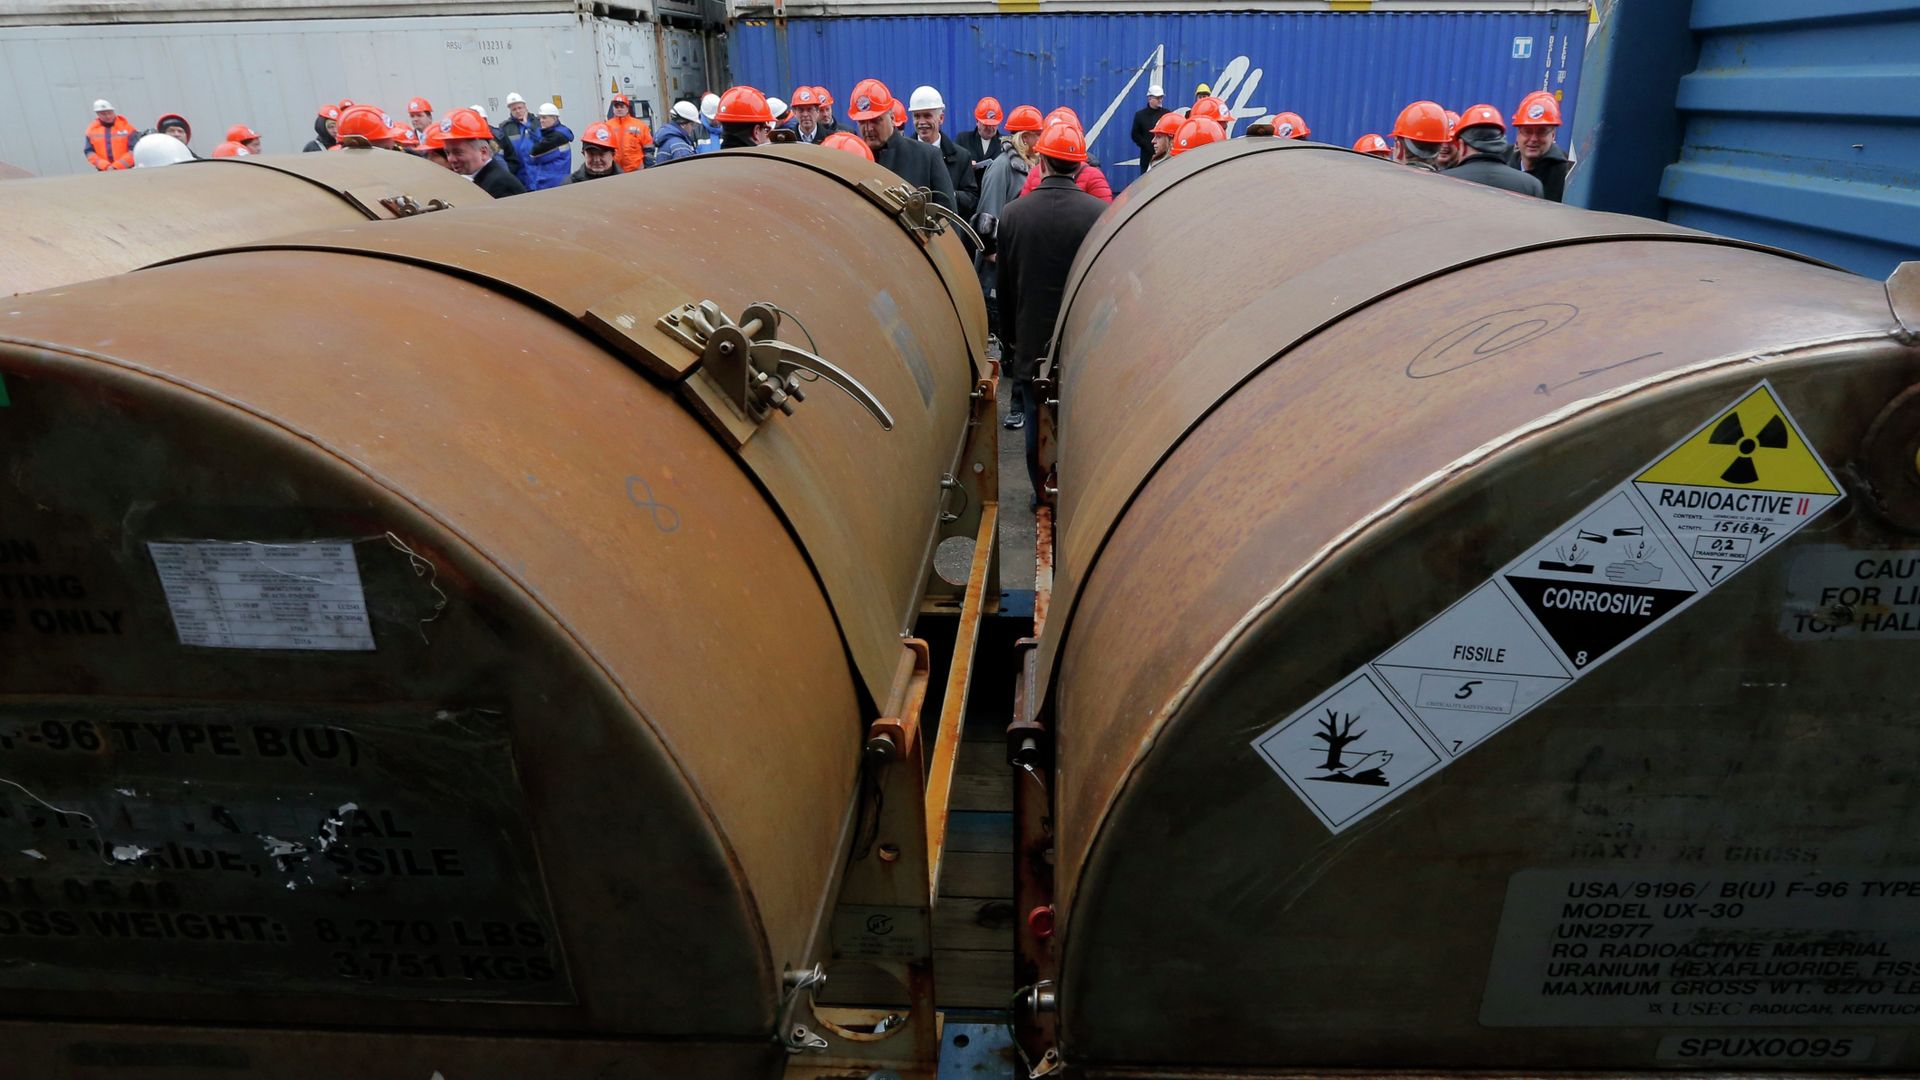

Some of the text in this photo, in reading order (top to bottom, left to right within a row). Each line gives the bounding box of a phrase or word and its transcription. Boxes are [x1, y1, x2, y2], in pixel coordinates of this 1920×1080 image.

[482, 56, 499, 65] 45R1
[1659, 488, 1810, 516] RADIOACTIVE II
[1711, 565, 1723, 580] 7
[1541, 587, 1655, 617] CORROSIVE
[1821, 586, 1920, 606] FOR LI
[30, 609, 123, 635] ONLY
[1861, 612, 1920, 632] HAL
[1453, 645, 1506, 663] FISSILE
[1575, 651, 1588, 666] 8
[110, 721, 242, 756] TYPE
[252, 724, 360, 767] B(U)
[1453, 740, 1463, 752] 7
[1720, 881, 1776, 899] B(U)
[1786, 881, 1849, 898] F-96
[1861, 881, 1920, 897] TYPE
[1562, 903, 1744, 918] MODEL UX-30
[88, 911, 288, 942] WEIGHT:
[314, 918, 439, 949] 8,270
[452, 920, 546, 948] LBS
[1558, 924, 1654, 938] UN2977
[1552, 942, 1891, 958] RQ RADIOACTIVE MATERIAL
[332, 951, 555, 981] 3,751 KGS
[1547, 962, 1660, 977] URANIUM
[1670, 962, 1861, 977] HEXAFLUORIDE,
[1542, 981, 1660, 996] MAXIMUM
[1671, 981, 1758, 995] GROSS
[1770, 981, 1811, 995] WT.
[1823, 980, 1885, 995] 8270
[1672, 1001, 1743, 1016] USEC
[1749, 1004, 1833, 1015] PADUCAH,
[1677, 1038, 1853, 1057] SPUX0095
